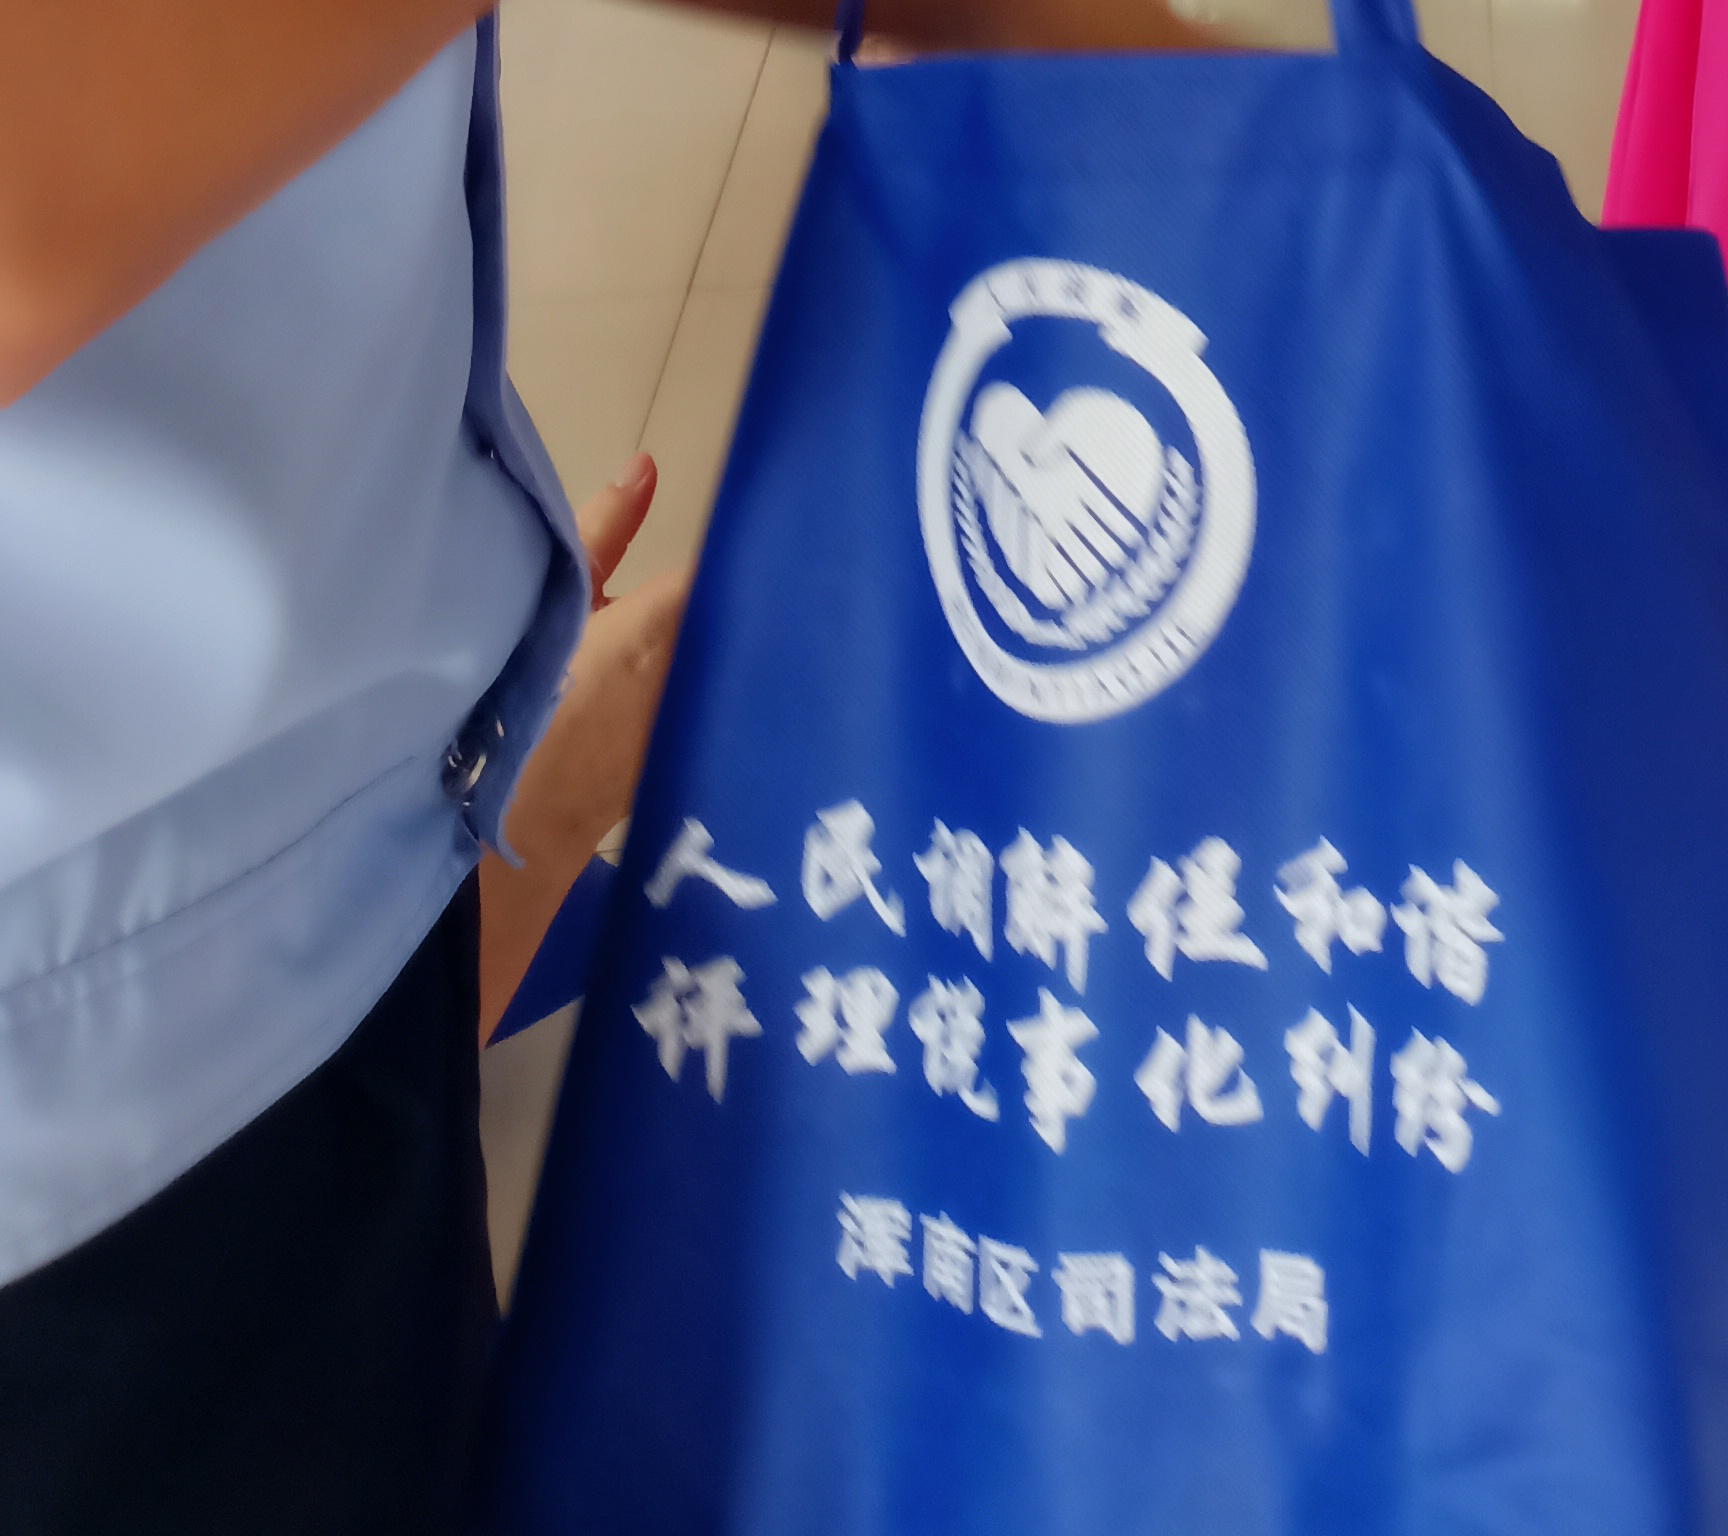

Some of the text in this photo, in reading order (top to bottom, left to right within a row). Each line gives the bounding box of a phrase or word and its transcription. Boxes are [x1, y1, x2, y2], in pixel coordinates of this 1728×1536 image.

[835, 1191, 1330, 1355] 浑南区司法局
